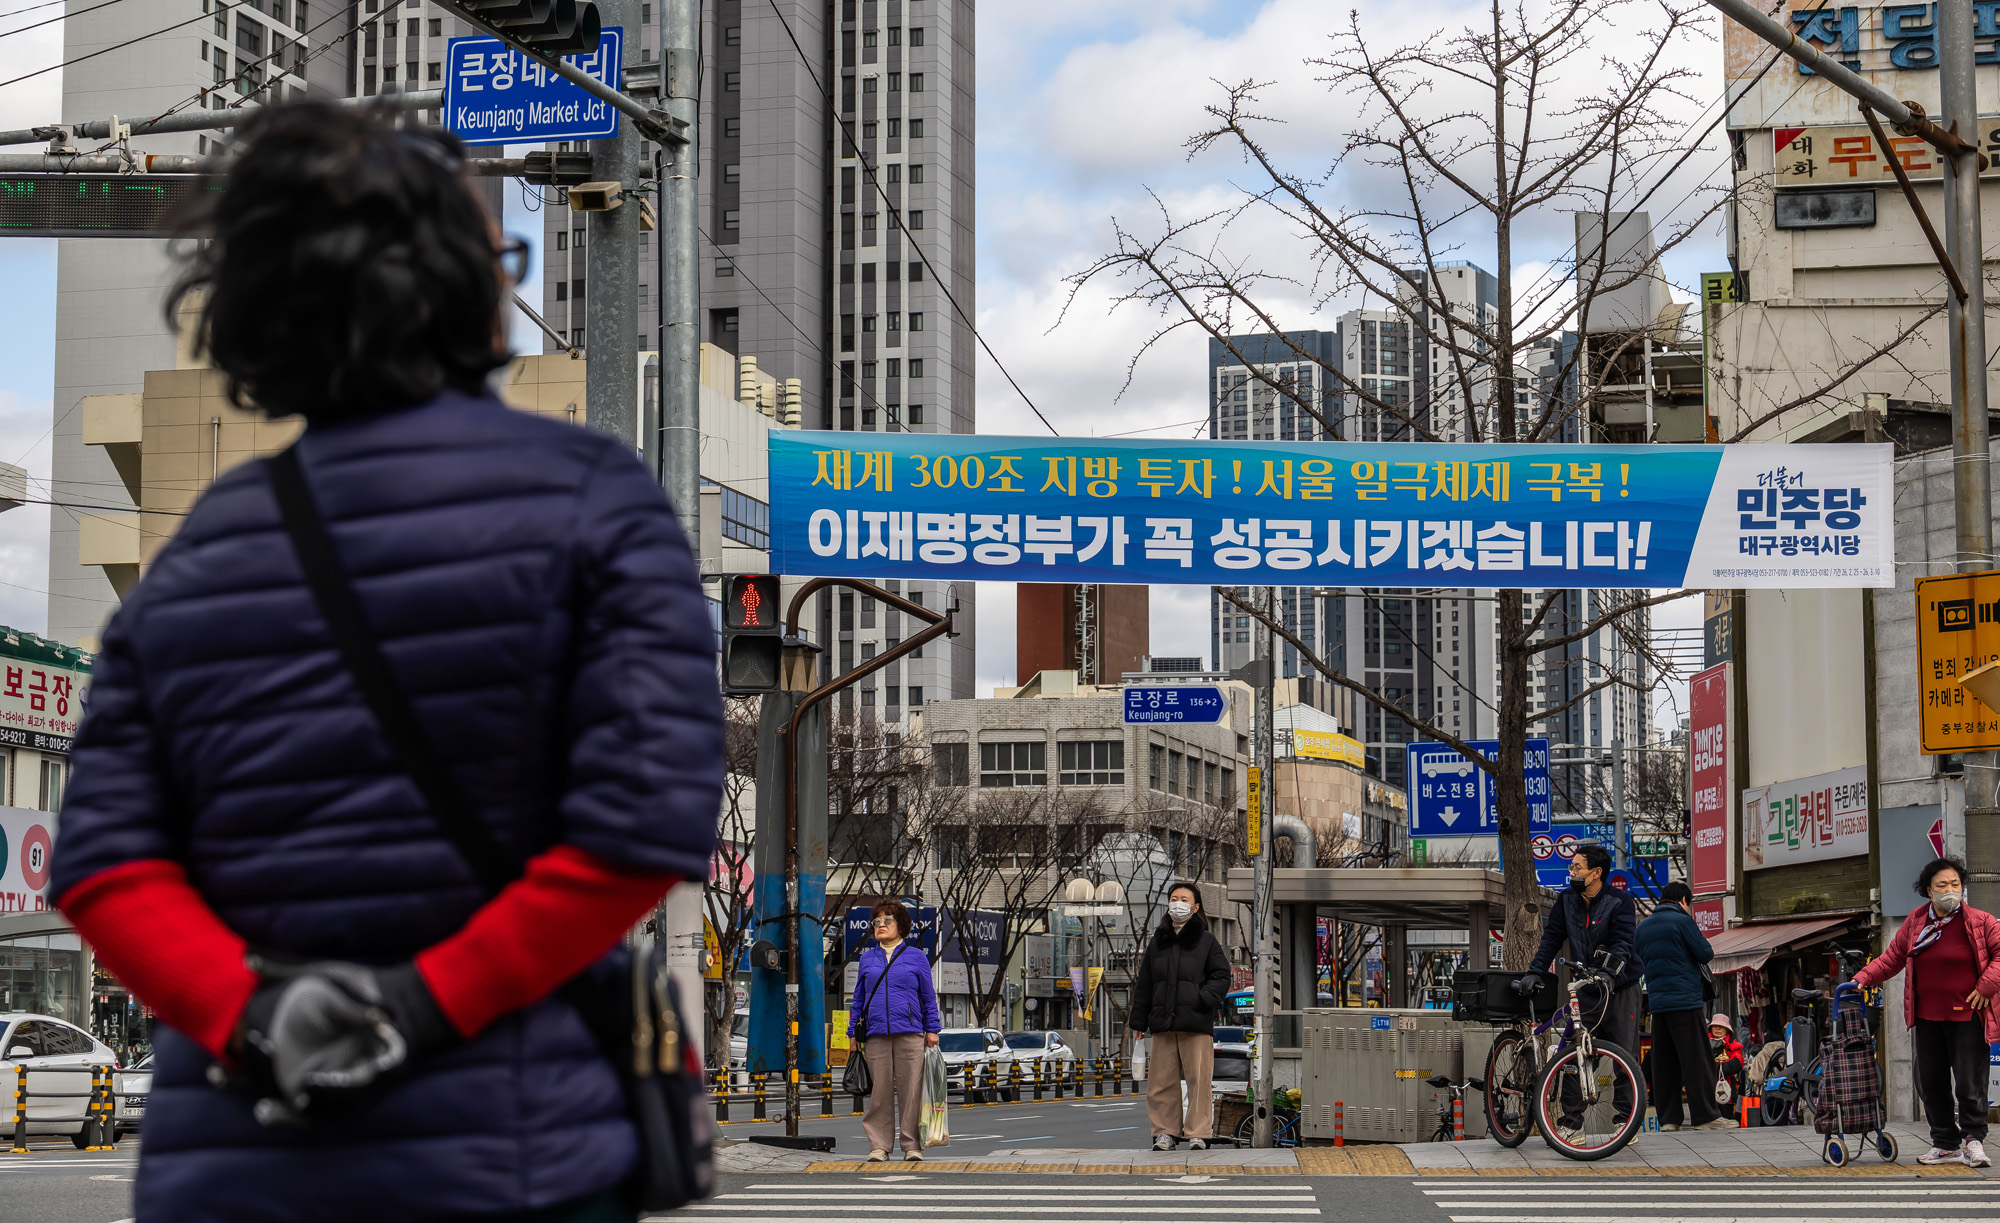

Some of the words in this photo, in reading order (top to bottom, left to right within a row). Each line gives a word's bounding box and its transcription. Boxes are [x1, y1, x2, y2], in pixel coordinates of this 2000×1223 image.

[457, 105, 524, 133] Keunjang
[529, 100, 579, 125] Market
[583, 98, 606, 122] Jct
[1791, 136, 1818, 178] 대화
[1828, 130, 2000, 177] 무도
[811, 449, 894, 492] 재계
[909, 454, 1026, 493] 300조
[1039, 455, 1123, 498] 지방
[1136, 457, 1217, 499] 투자
[1254, 459, 1336, 500] 서울
[1350, 460, 1511, 502] 일극체제
[1526, 462, 1604, 502] 극복
[1756, 465, 1804, 491] 더불어
[1736, 487, 1867, 530] 민주당
[807, 508, 1130, 566] 이재명정부가
[1144, 517, 1195, 568] 꼭
[1209, 517, 1653, 571] 성공시키겠습니다!
[1738, 535, 1861, 557] 대구광역시당
[1933, 657, 1957, 680] 범죄
[3, 664, 73, 717] 보금장
[1128, 690, 1180, 709] 큰장로
[1189, 698, 1204, 707] 136
[1928, 686, 1965, 709] 카메라
[27, 714, 46, 730] 최고가
[1128, 709, 1184, 722] Keunjang-ro
[1941, 719, 1998, 736] 중부경찰서
[1422, 782, 1475, 799] 버스전용
[1834, 780, 1867, 810] 주문/제작
[1531, 803, 1548, 823] 제외
[32, 847, 42, 867] 91
[1235, 997, 1247, 1006] 156
